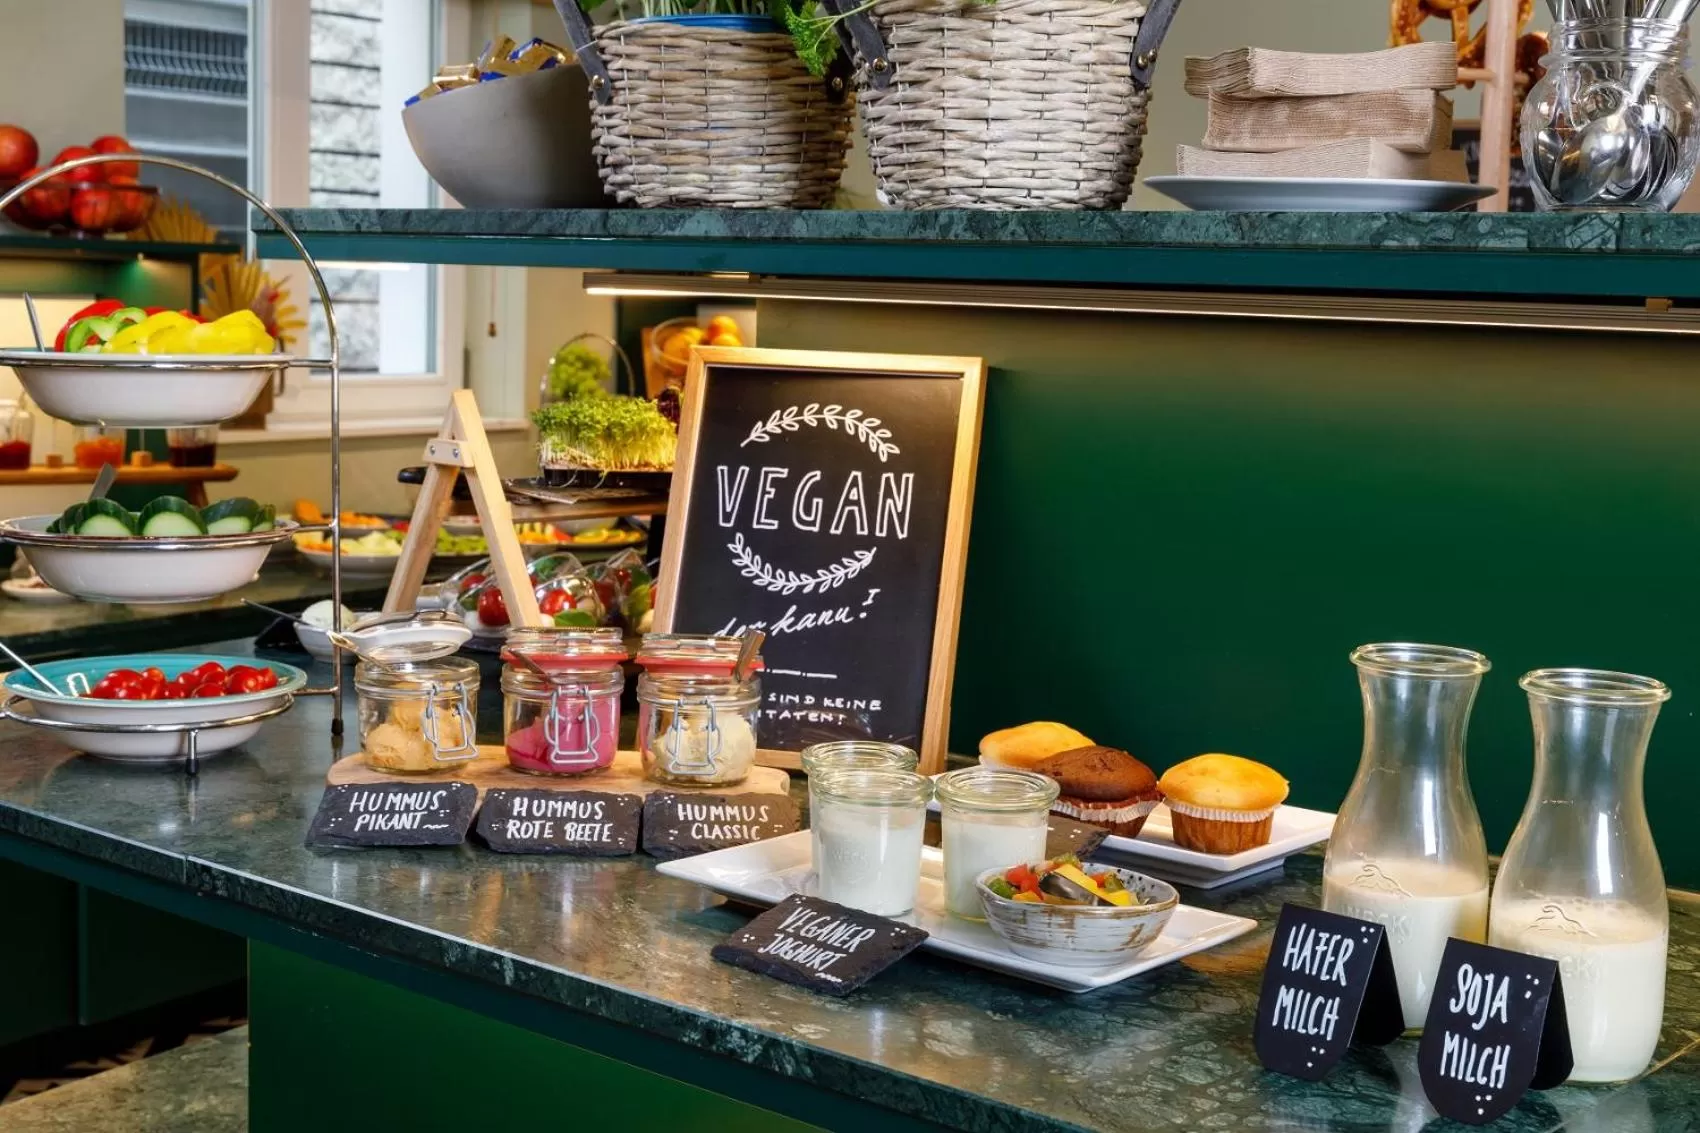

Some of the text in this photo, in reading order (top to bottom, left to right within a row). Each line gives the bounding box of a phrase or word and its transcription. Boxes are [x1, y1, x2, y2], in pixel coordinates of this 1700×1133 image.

[716, 465, 915, 539] VEGAN
[767, 691, 882, 711] SIND KEINE
[756, 708, 848, 726] ITATEN!
[348, 789, 448, 813] HUMMUS
[512, 796, 606, 820] HUMMUS
[677, 803, 770, 823] HUMMUS
[353, 811, 428, 832] PIKANT
[506, 818, 554, 839] ROTE
[691, 822, 761, 841] CLASSIC
[777, 906, 876, 953] VEGANER
[757, 933, 848, 972] JOGHURT
[1282, 922, 1355, 987] HAFER
[1449, 962, 1511, 1031] SOJA
[1271, 984, 1341, 1041] MILCH
[1439, 1030, 1512, 1090] MILCH
